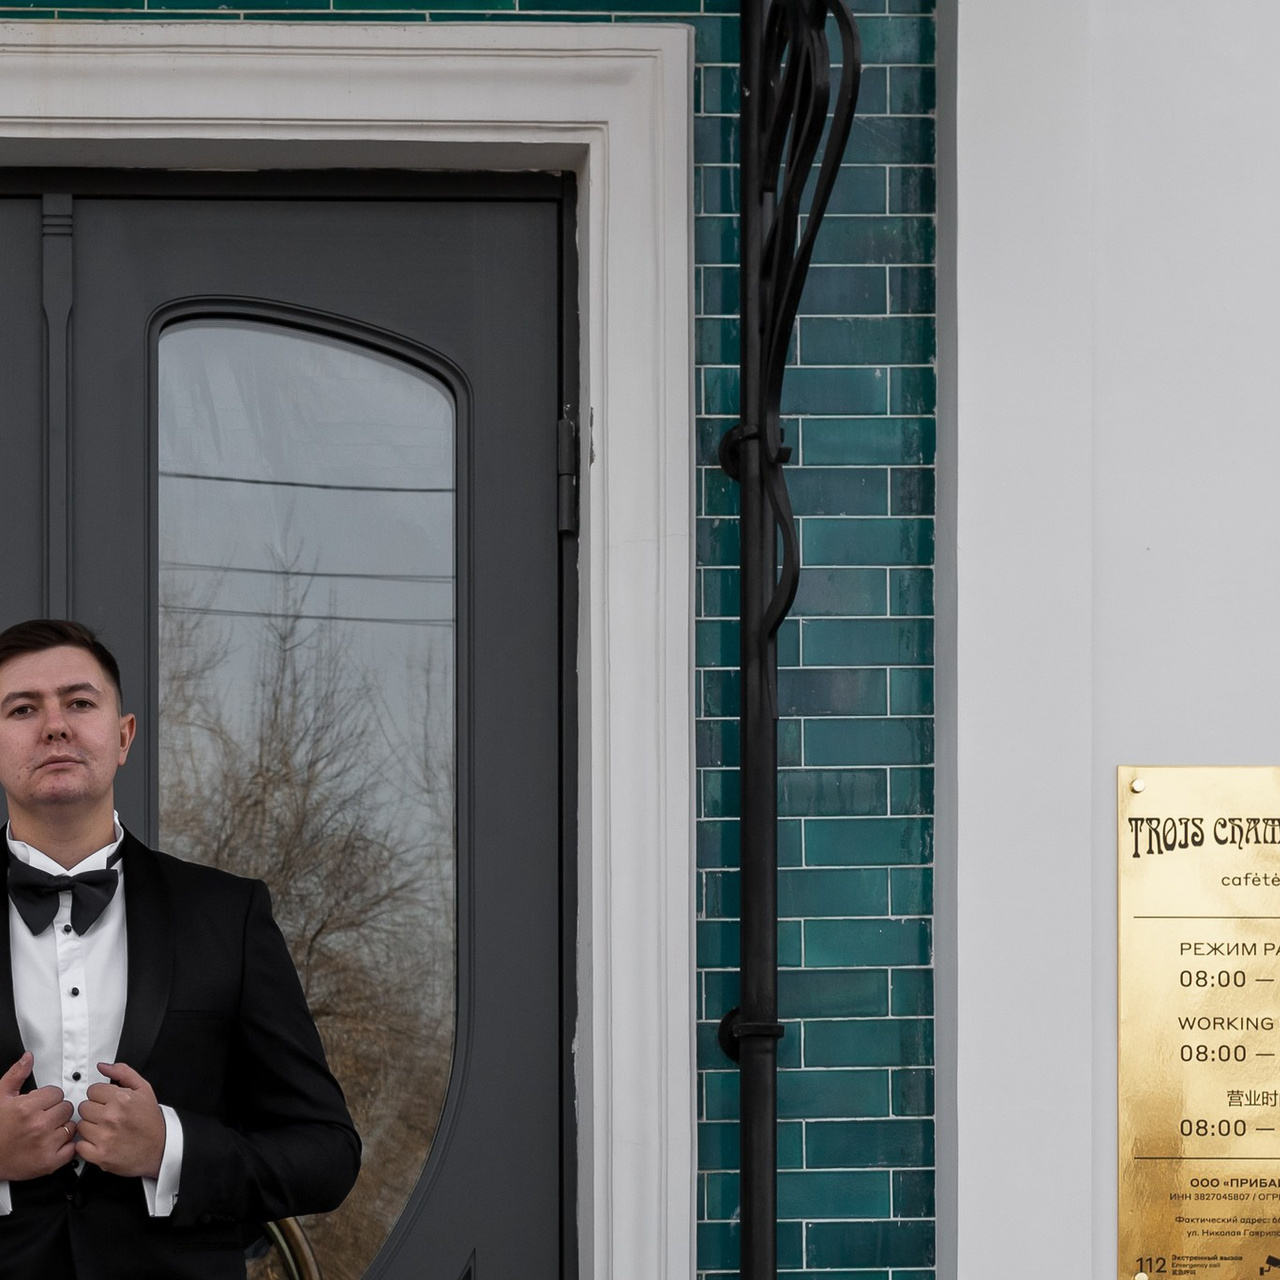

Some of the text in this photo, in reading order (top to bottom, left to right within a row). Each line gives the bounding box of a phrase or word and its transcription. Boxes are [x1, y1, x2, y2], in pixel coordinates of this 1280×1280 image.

[1128, 817, 1205, 858] TROIS
[1180, 942, 1257, 956] РЕЖИМ
[1180, 970, 1246, 988] 08:00
[1178, 1017, 1275, 1031] WORKING
[1180, 1045, 1247, 1062] 08:00
[1227, 1090, 1280, 1107] 营业时
[1180, 1119, 1247, 1137] 08:00
[1190, 1178, 1280, 1188] ООО «ПРИБА
[1169, 1193, 1192, 1201] ИНН
[1194, 1193, 1250, 1201] 3827045807
[1258, 1193, 1280, 1201] ОГР
[1175, 1216, 1238, 1224] Фактический
[1201, 1229, 1242, 1237] Николая
[1135, 1257, 1167, 1273] 112
